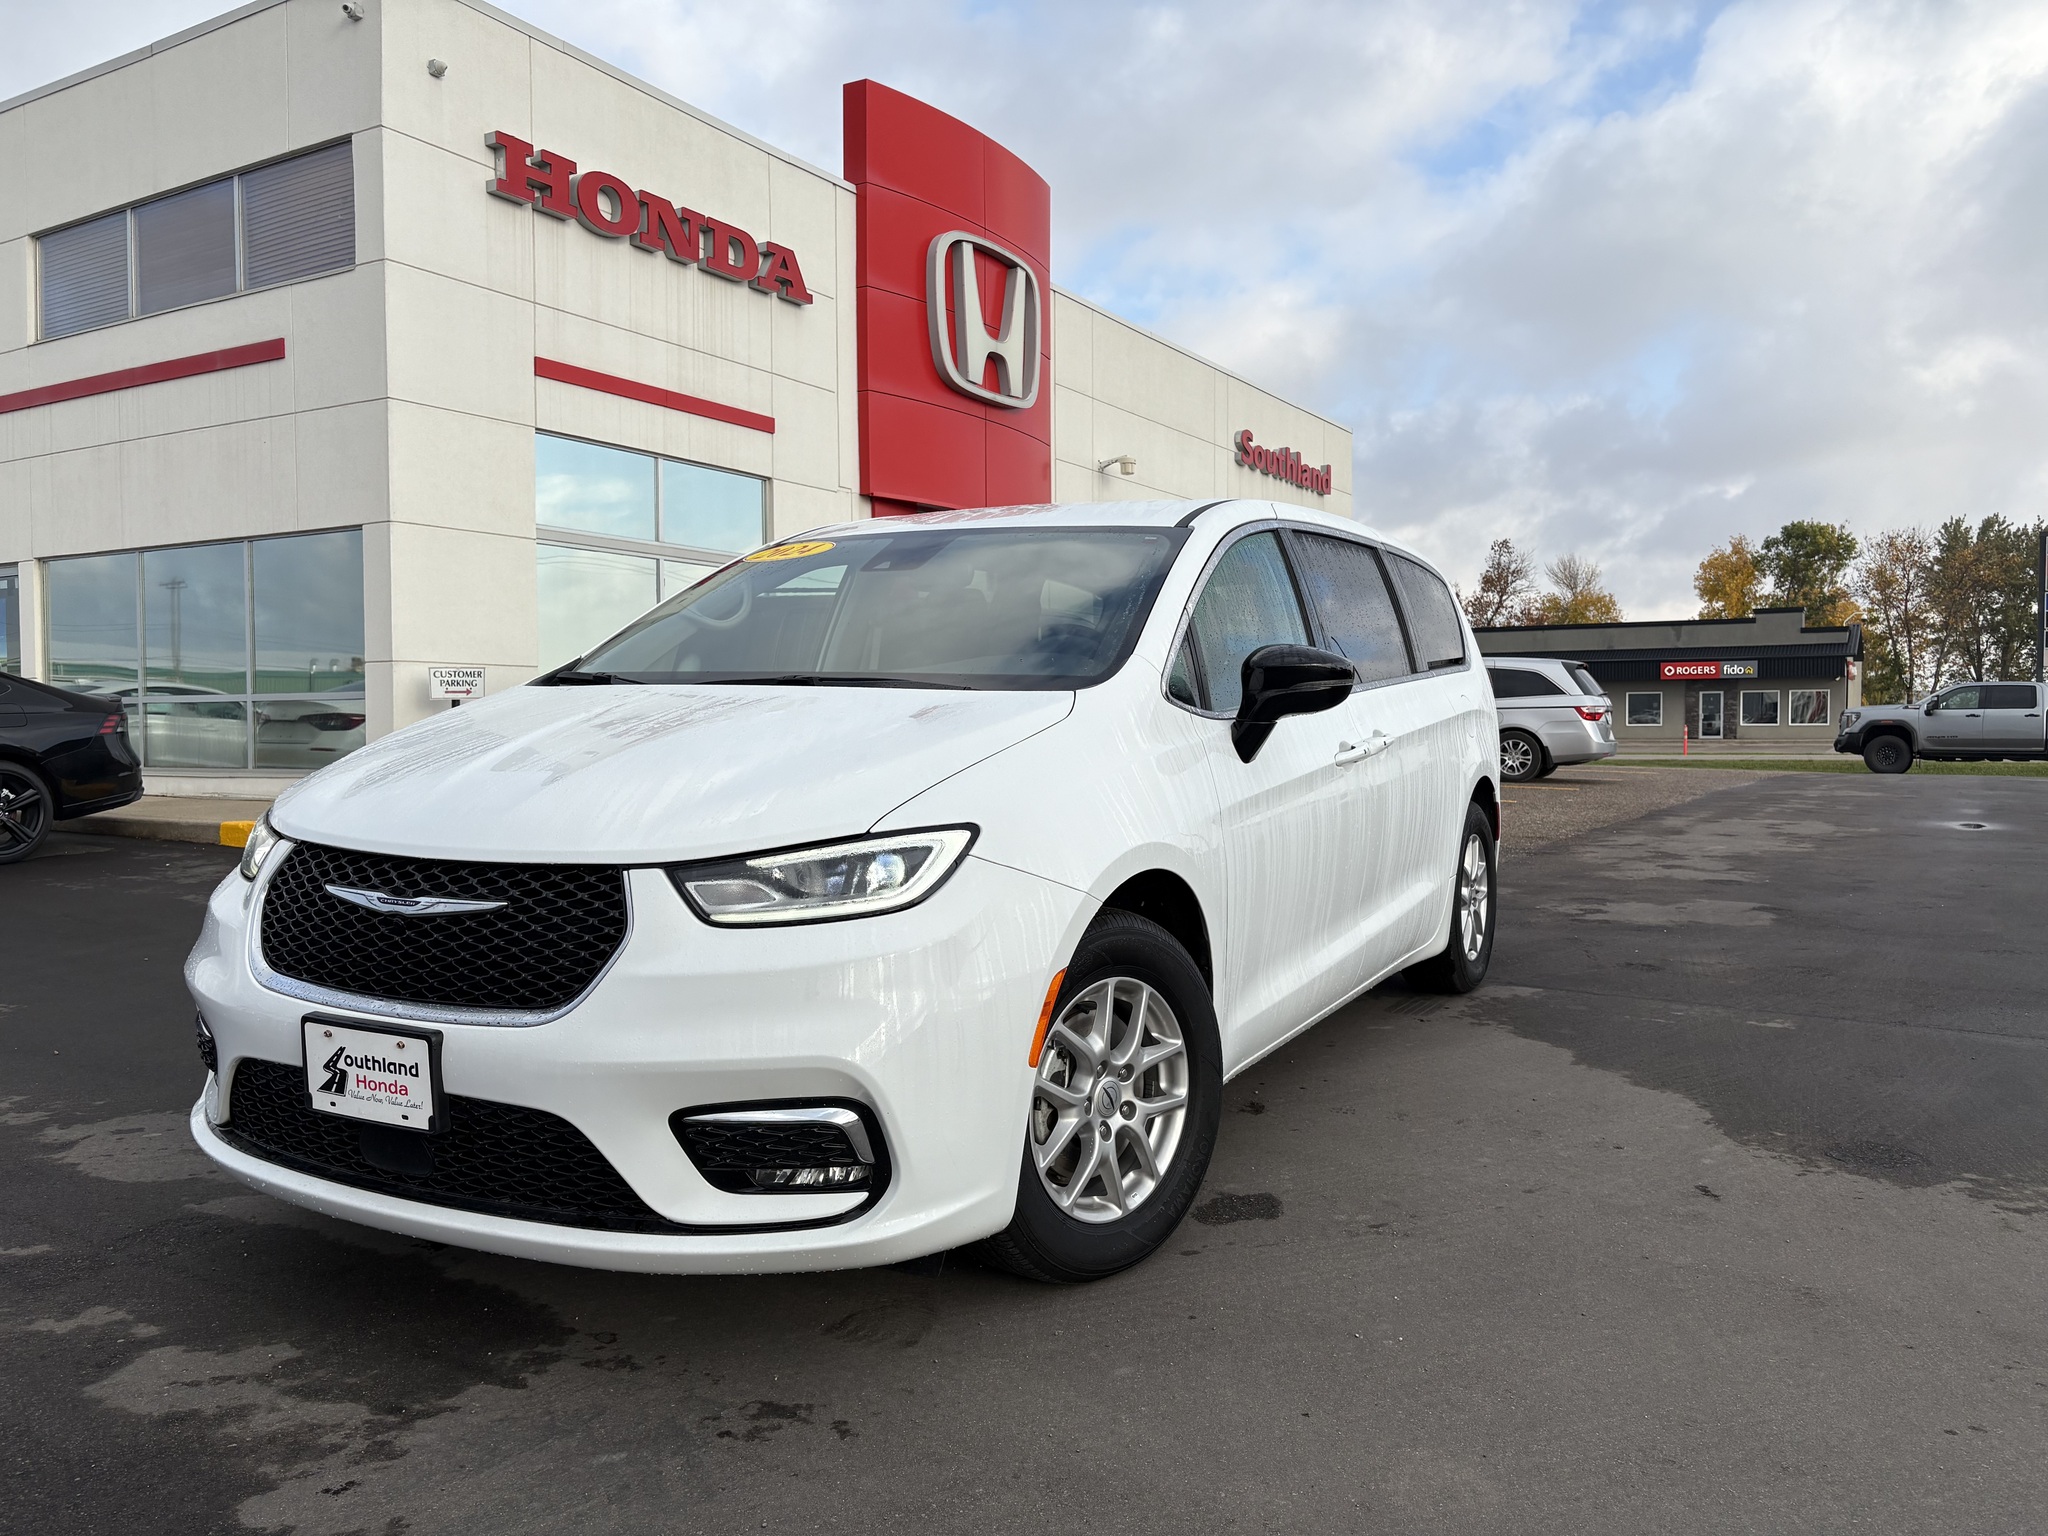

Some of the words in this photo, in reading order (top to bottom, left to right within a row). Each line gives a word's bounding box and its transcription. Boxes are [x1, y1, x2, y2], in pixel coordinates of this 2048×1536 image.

[493, 130, 813, 304] HONDA
[1239, 429, 1331, 495] Southland
[433, 670, 483, 679] CUSTOMER
[1676, 666, 1716, 675] ROGERS
[1723, 664, 1744, 675] fido
[440, 679, 478, 687] PARKING
[380, 898, 416, 906] CHRYSLER
[356, 1073, 409, 1096] Honda
[347, 1089, 365, 1101] Value
[385, 1095, 403, 1107] Value
